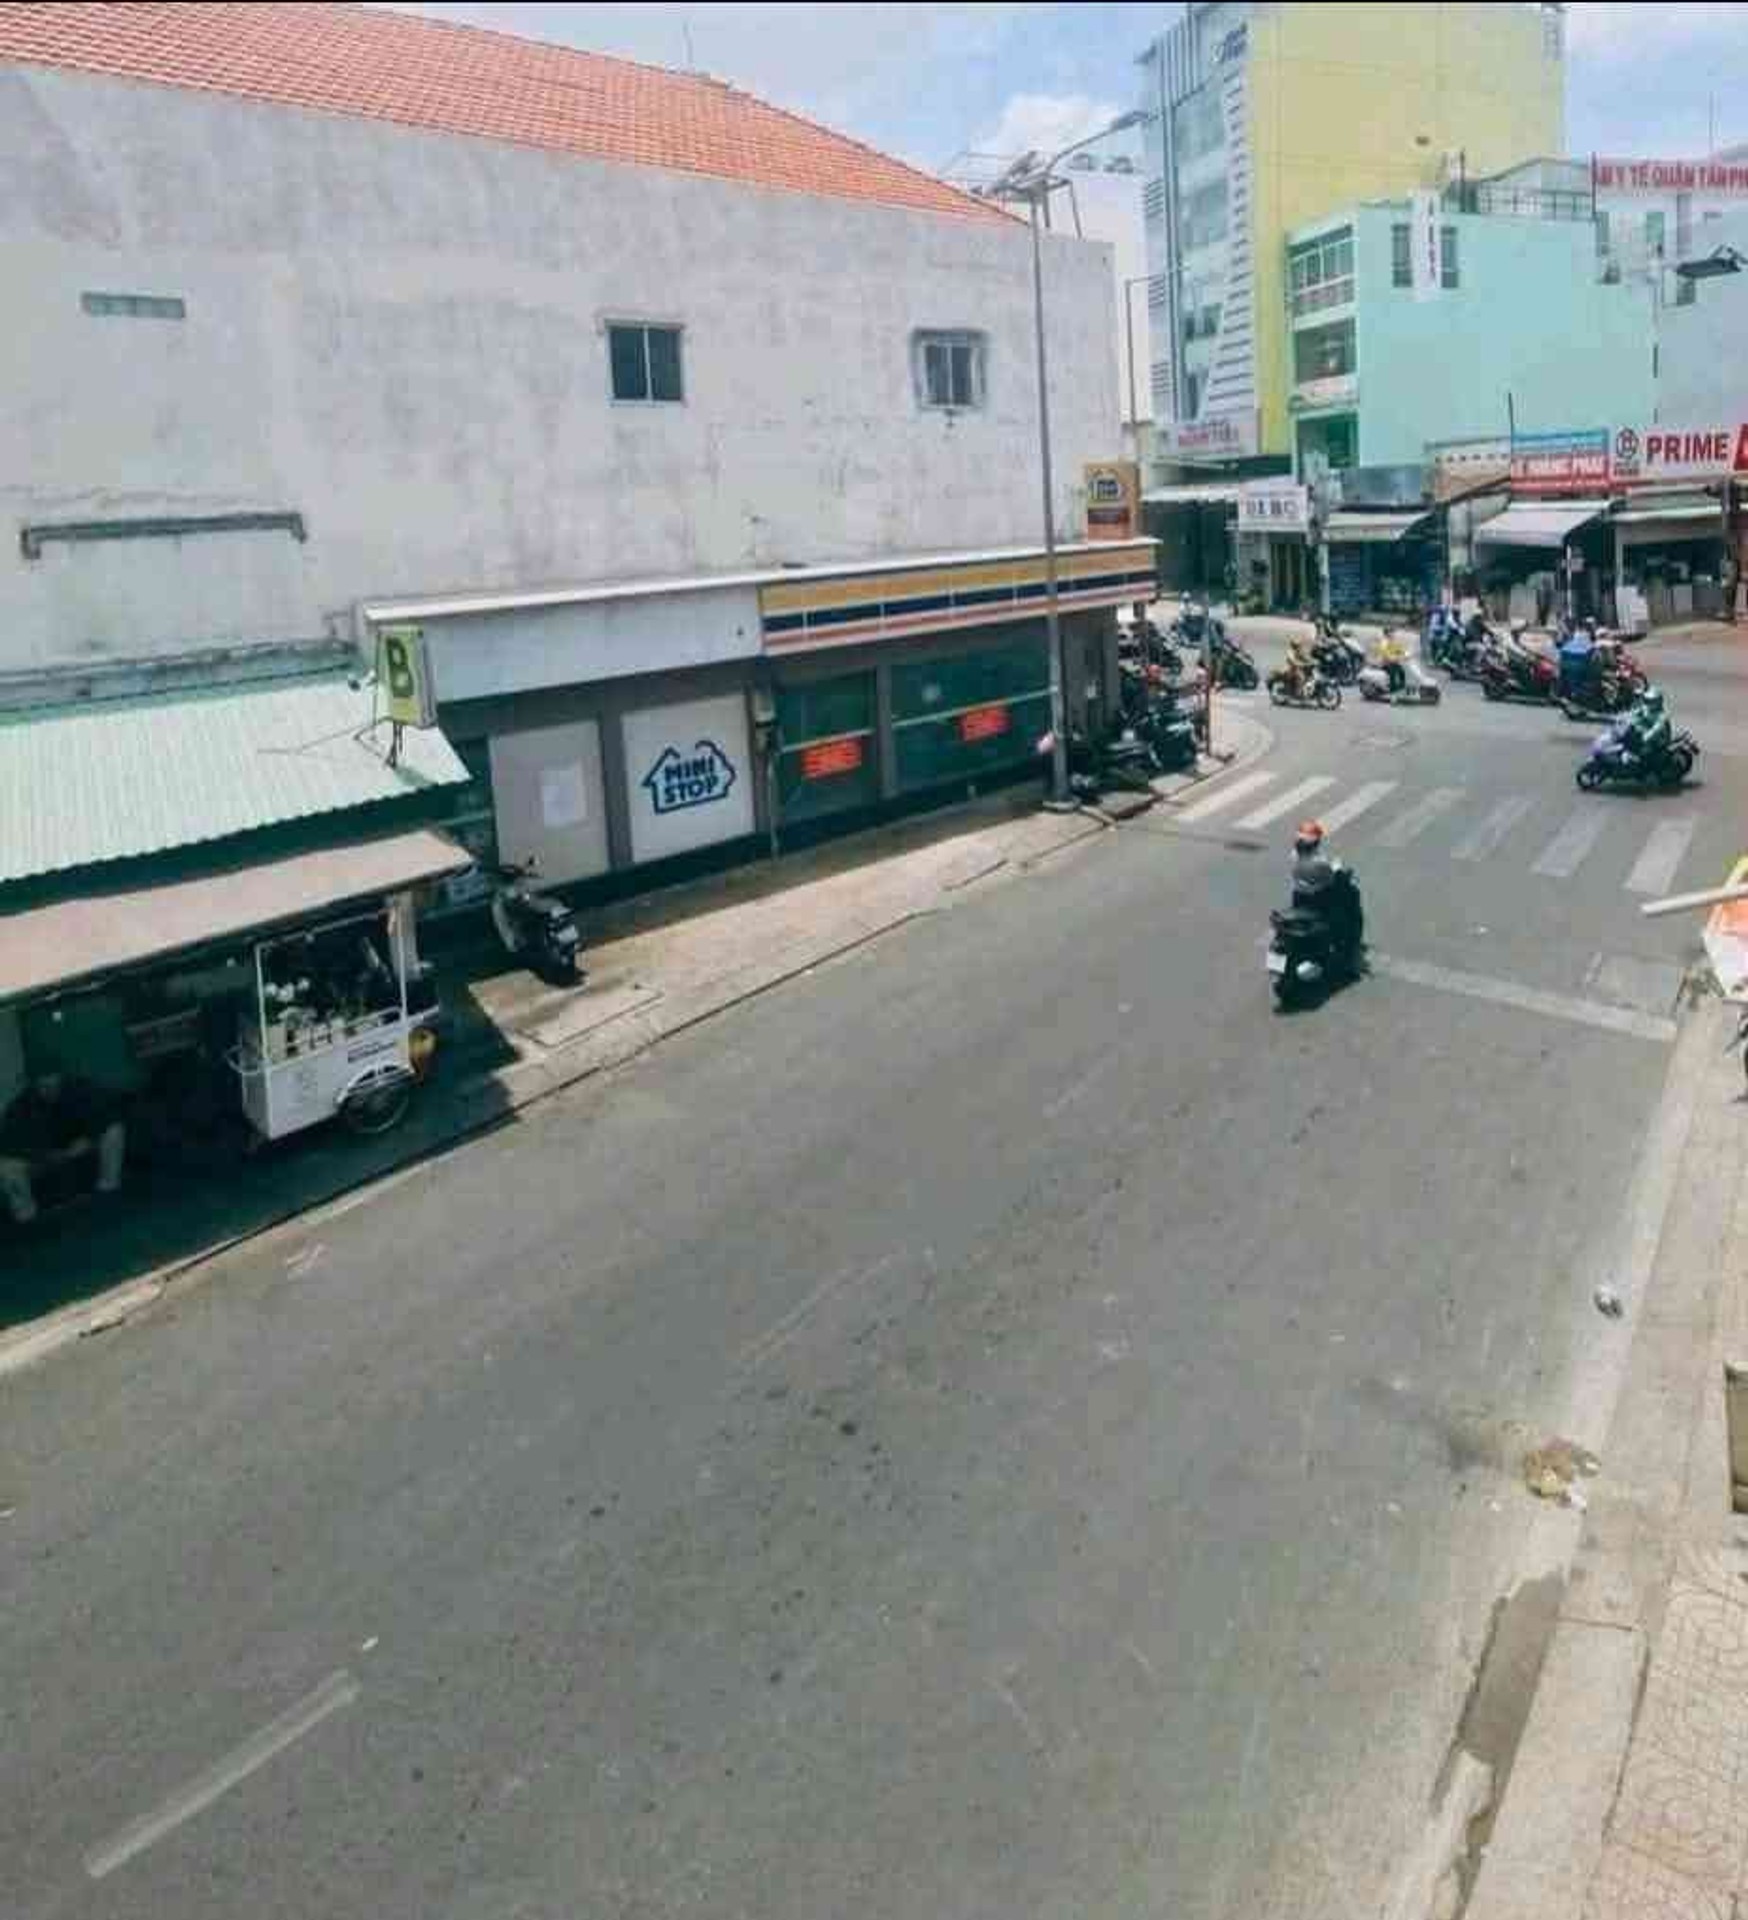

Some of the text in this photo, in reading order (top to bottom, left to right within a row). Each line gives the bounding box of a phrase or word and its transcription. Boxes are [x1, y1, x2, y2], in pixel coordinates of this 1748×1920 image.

[1646, 431, 1730, 466] PRIME
[664, 756, 715, 782] MINI
[664, 774, 720, 804] STOP
